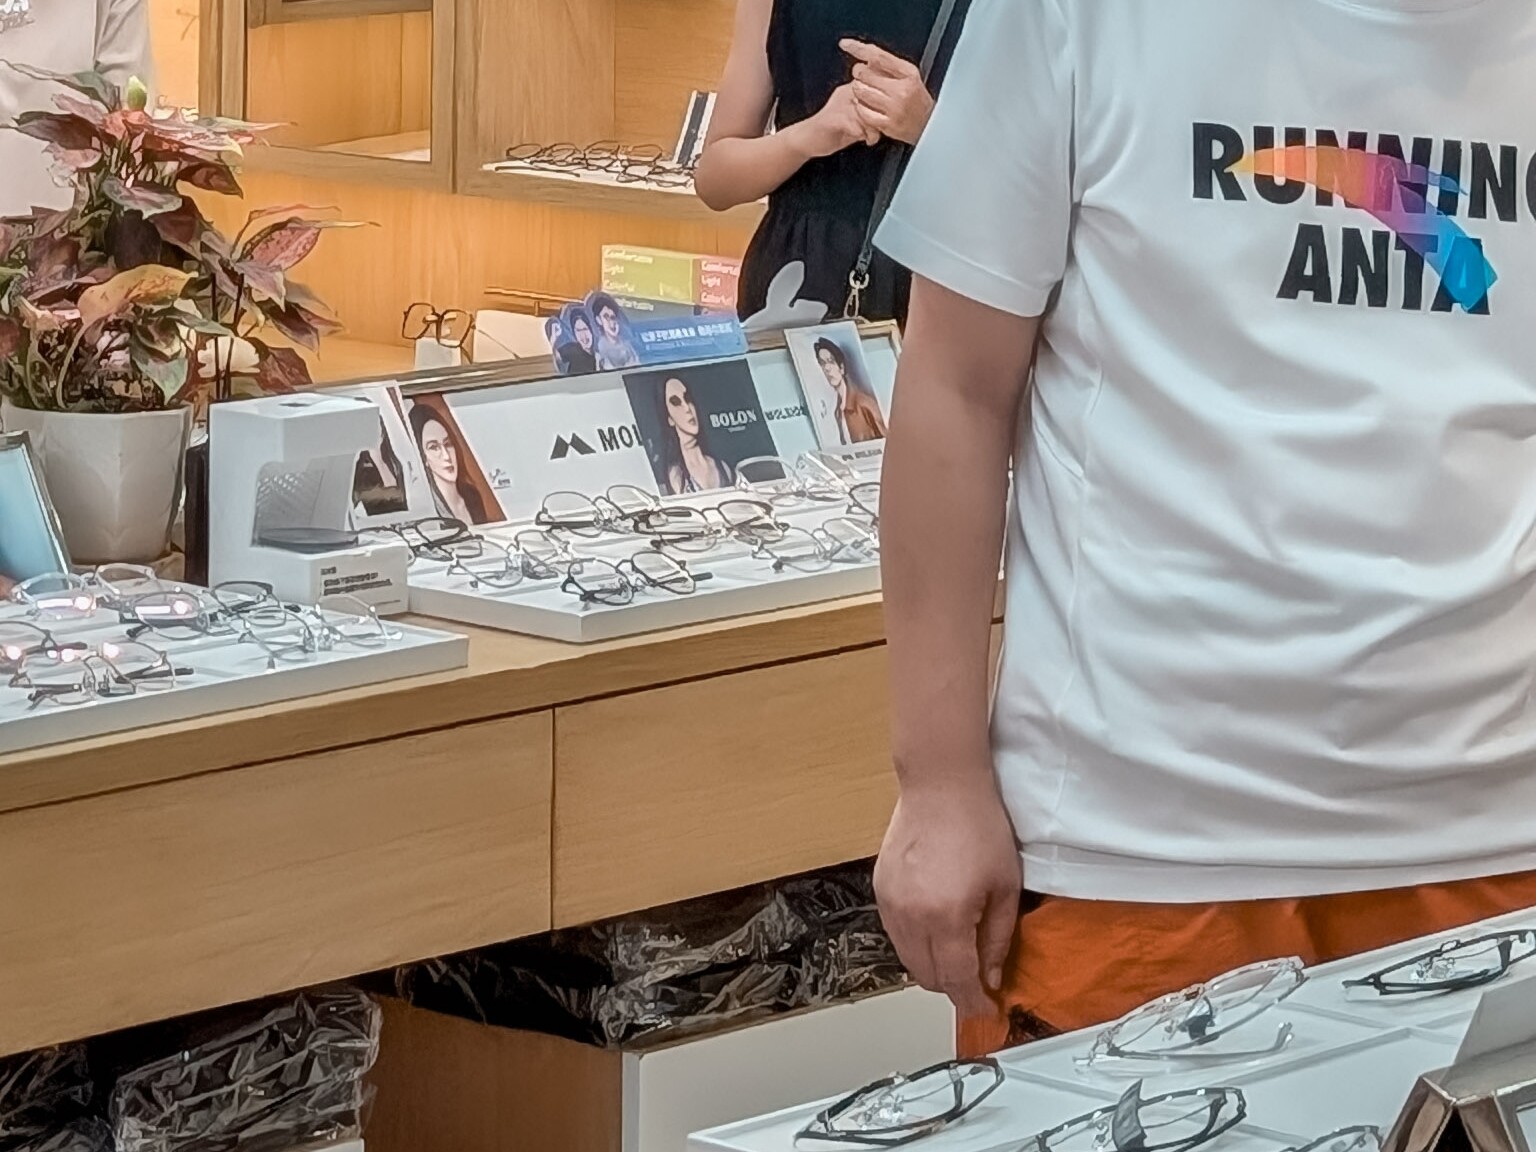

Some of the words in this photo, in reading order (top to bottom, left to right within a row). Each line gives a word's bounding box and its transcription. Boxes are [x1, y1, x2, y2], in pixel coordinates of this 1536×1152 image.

[1192, 122, 1536, 223] RUNNIN
[1276, 223, 1491, 316] ANTA
[710, 408, 757, 429] BOLON
